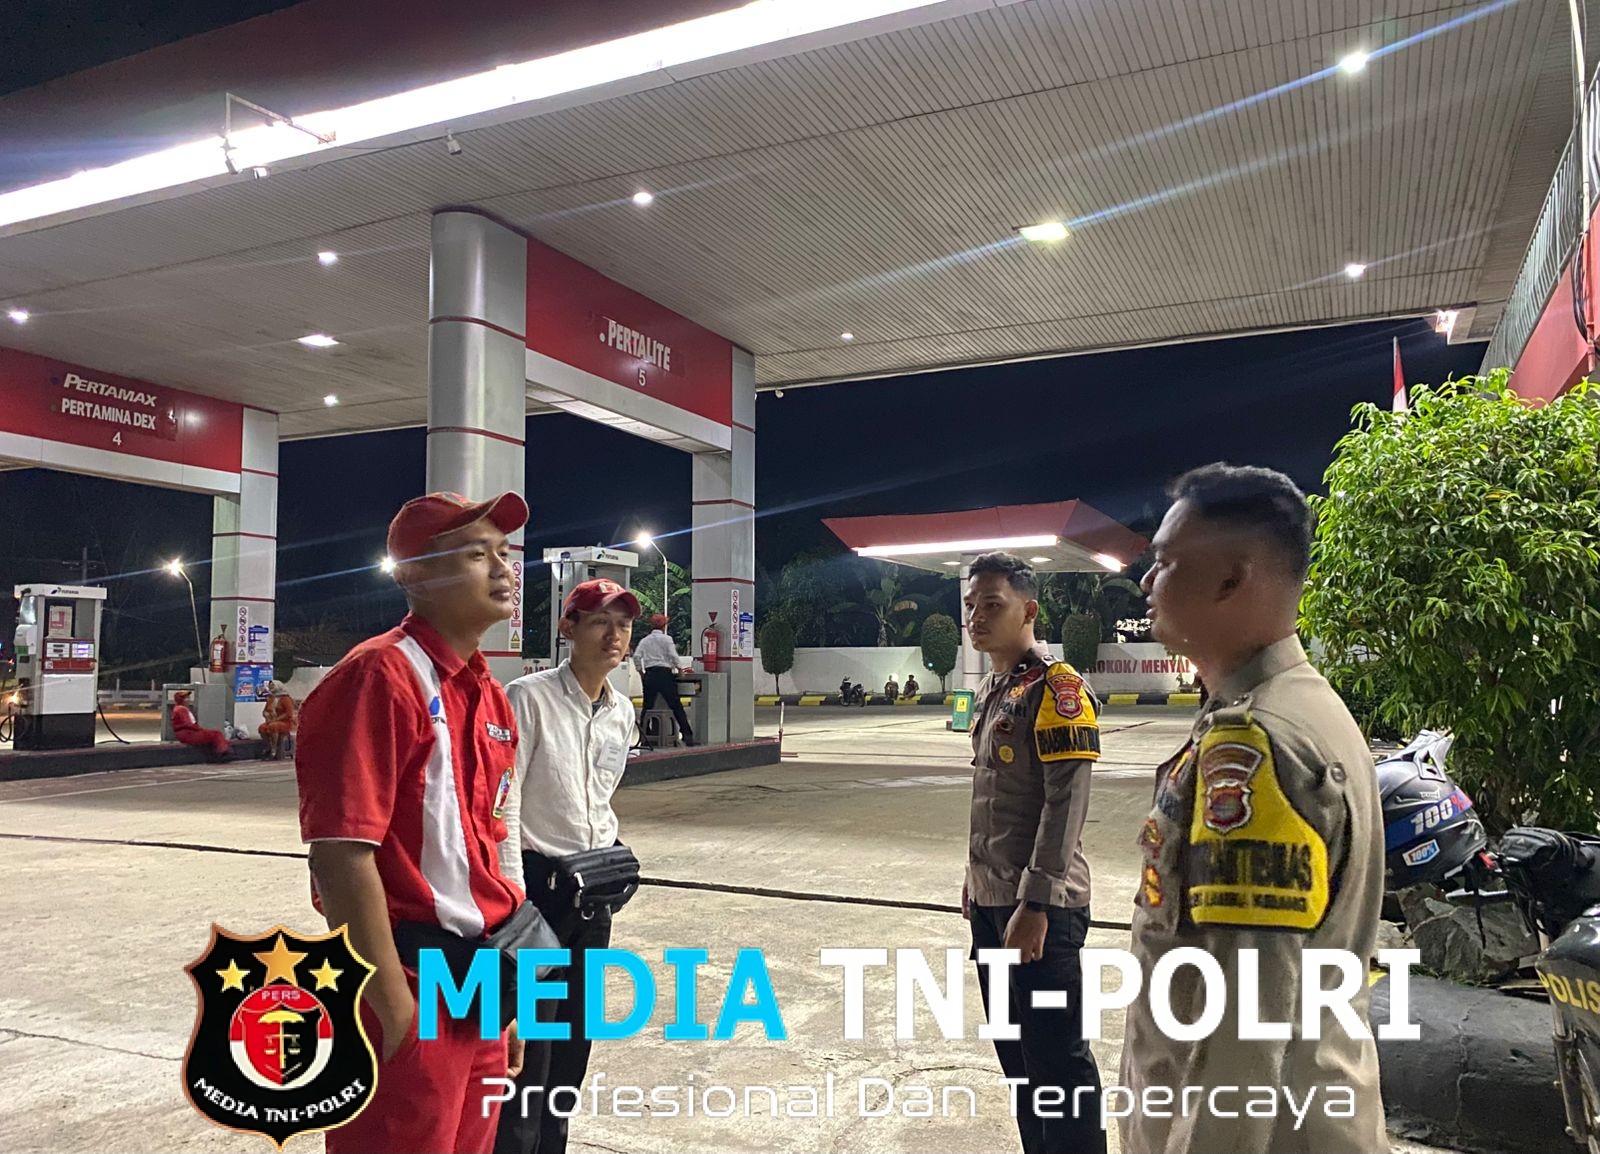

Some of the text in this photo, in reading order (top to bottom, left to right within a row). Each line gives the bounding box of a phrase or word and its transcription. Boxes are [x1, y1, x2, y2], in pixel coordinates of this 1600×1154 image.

[608, 318, 671, 371] PERTALITE
[63, 373, 157, 407] PERTAMAX
[638, 368, 646, 386] 5
[61, 398, 156, 430] PERTAMINA DEX
[112, 431, 122, 446] 4
[1411, 794, 1465, 835] 100%
